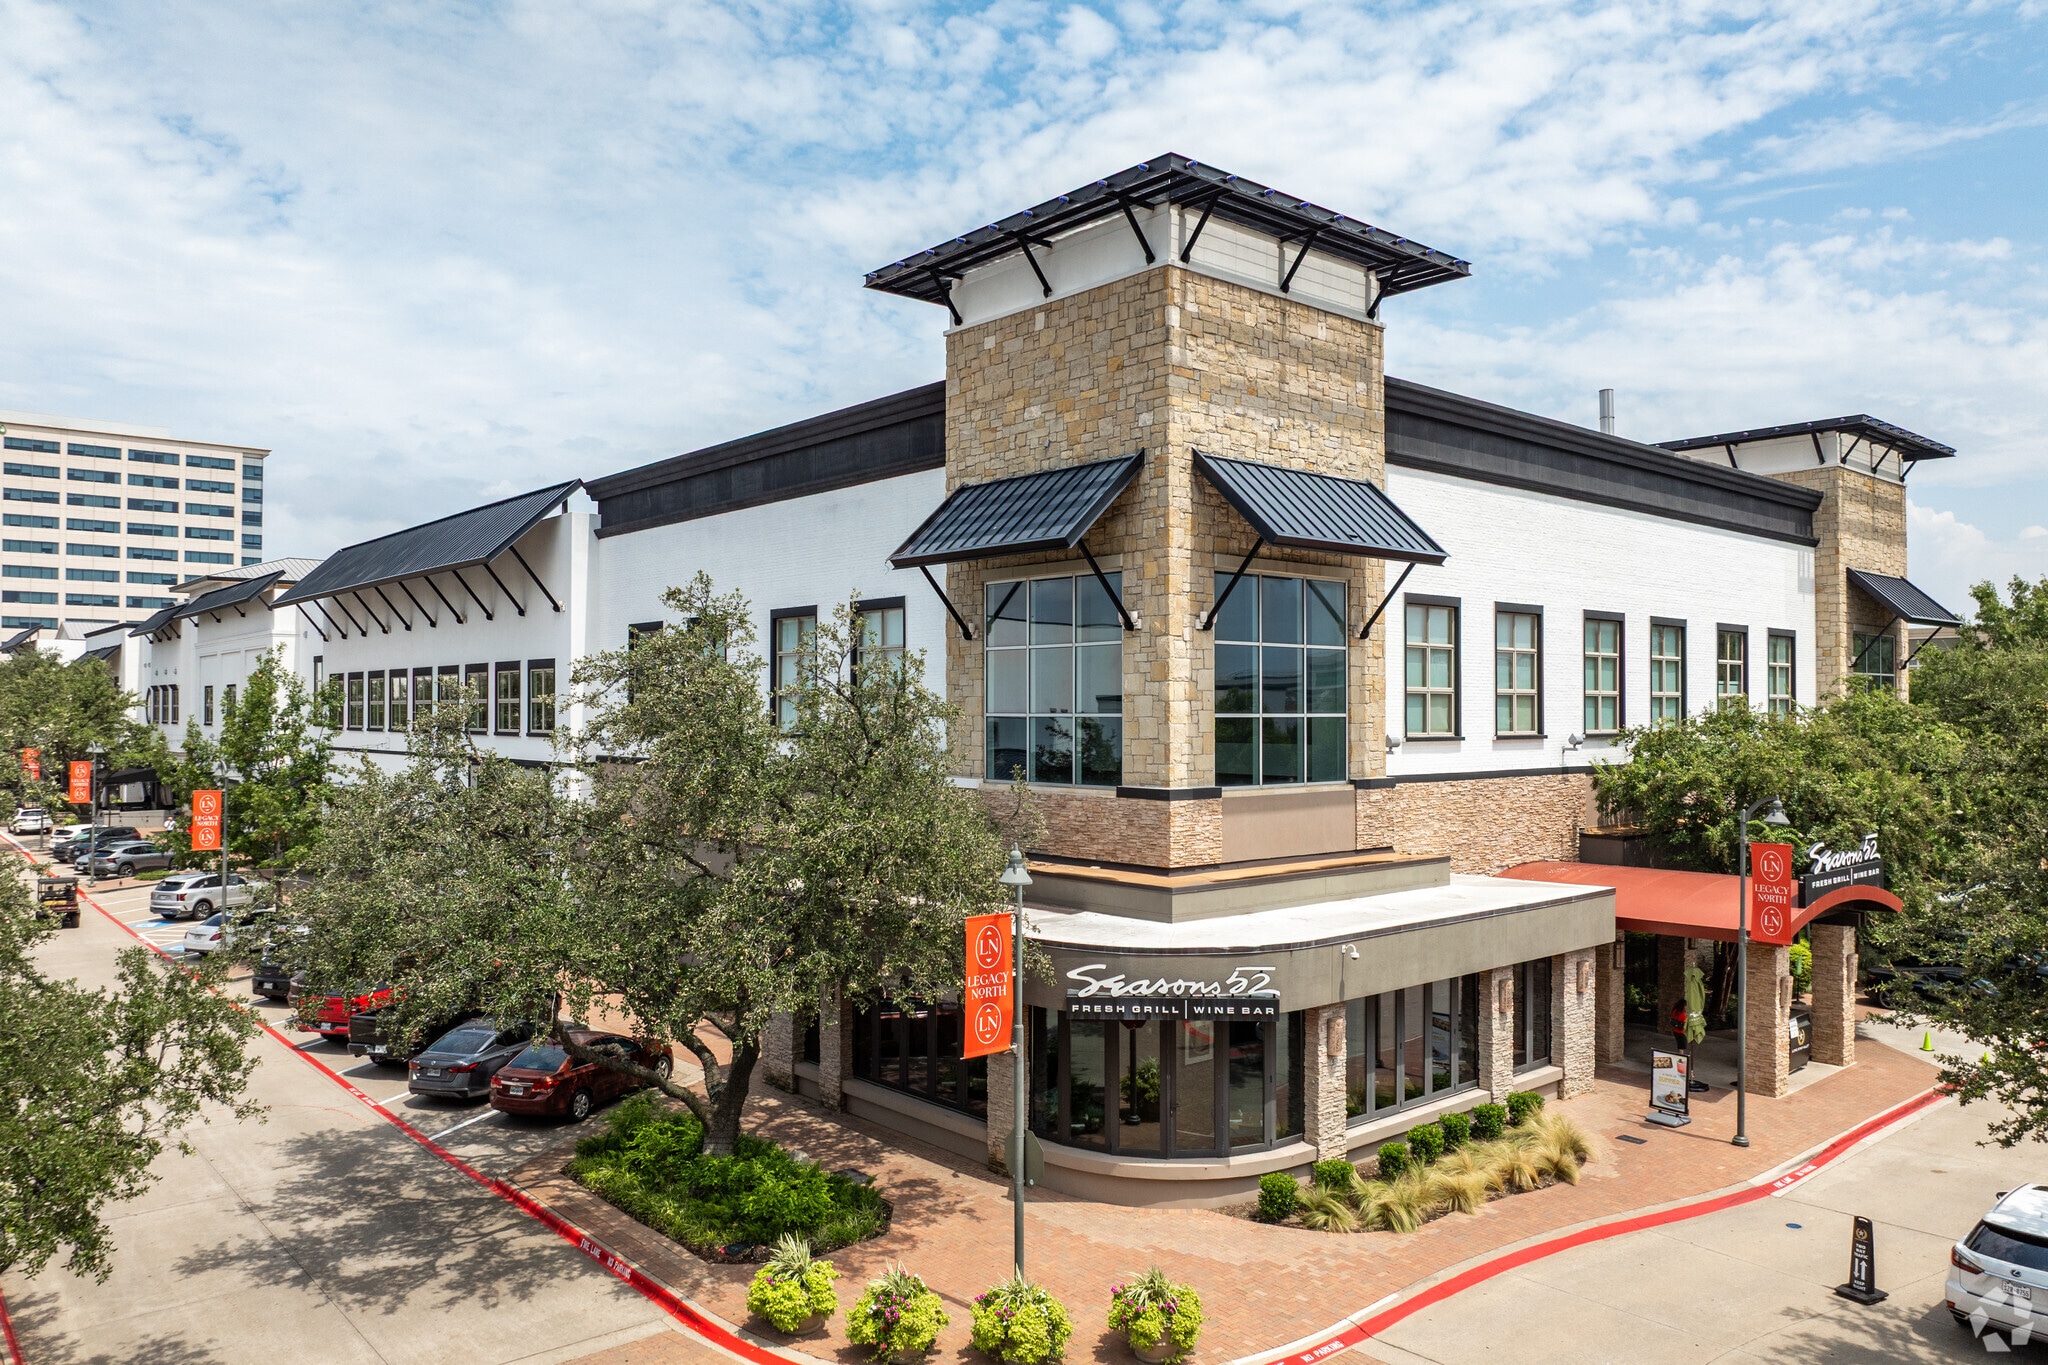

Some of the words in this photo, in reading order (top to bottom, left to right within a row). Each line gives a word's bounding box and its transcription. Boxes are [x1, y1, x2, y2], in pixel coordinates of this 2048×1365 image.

[1807, 842, 1863, 875] Seasons
[1862, 833, 1881, 860] 52
[1763, 860, 1780, 873] LN
[1812, 878, 1832, 888] FRESH
[1833, 875, 1850, 884] GRILL
[1853, 871, 1867, 879] WINE
[1868, 868, 1880, 876] BAR
[1754, 883, 1790, 895] LEGACY
[1757, 893, 1787, 904] NORTH
[1763, 915, 1780, 927] LN
[979, 938, 999, 956] LN
[967, 971, 1010, 988] LEGACY
[1066, 964, 1221, 998] Seasons
[1225, 966, 1281, 996] 52
[971, 984, 1007, 1000] NORTH
[1071, 1004, 1125, 1014] FRESH
[1131, 1005, 1180, 1014] GRILL
[1193, 1006, 1235, 1015] WINE
[1241, 1006, 1275, 1015] BAR
[979, 1015, 999, 1032] LN
[1300, 1353, 1315, 1362] NO
[1313, 1340, 1345, 1357] PARKING
